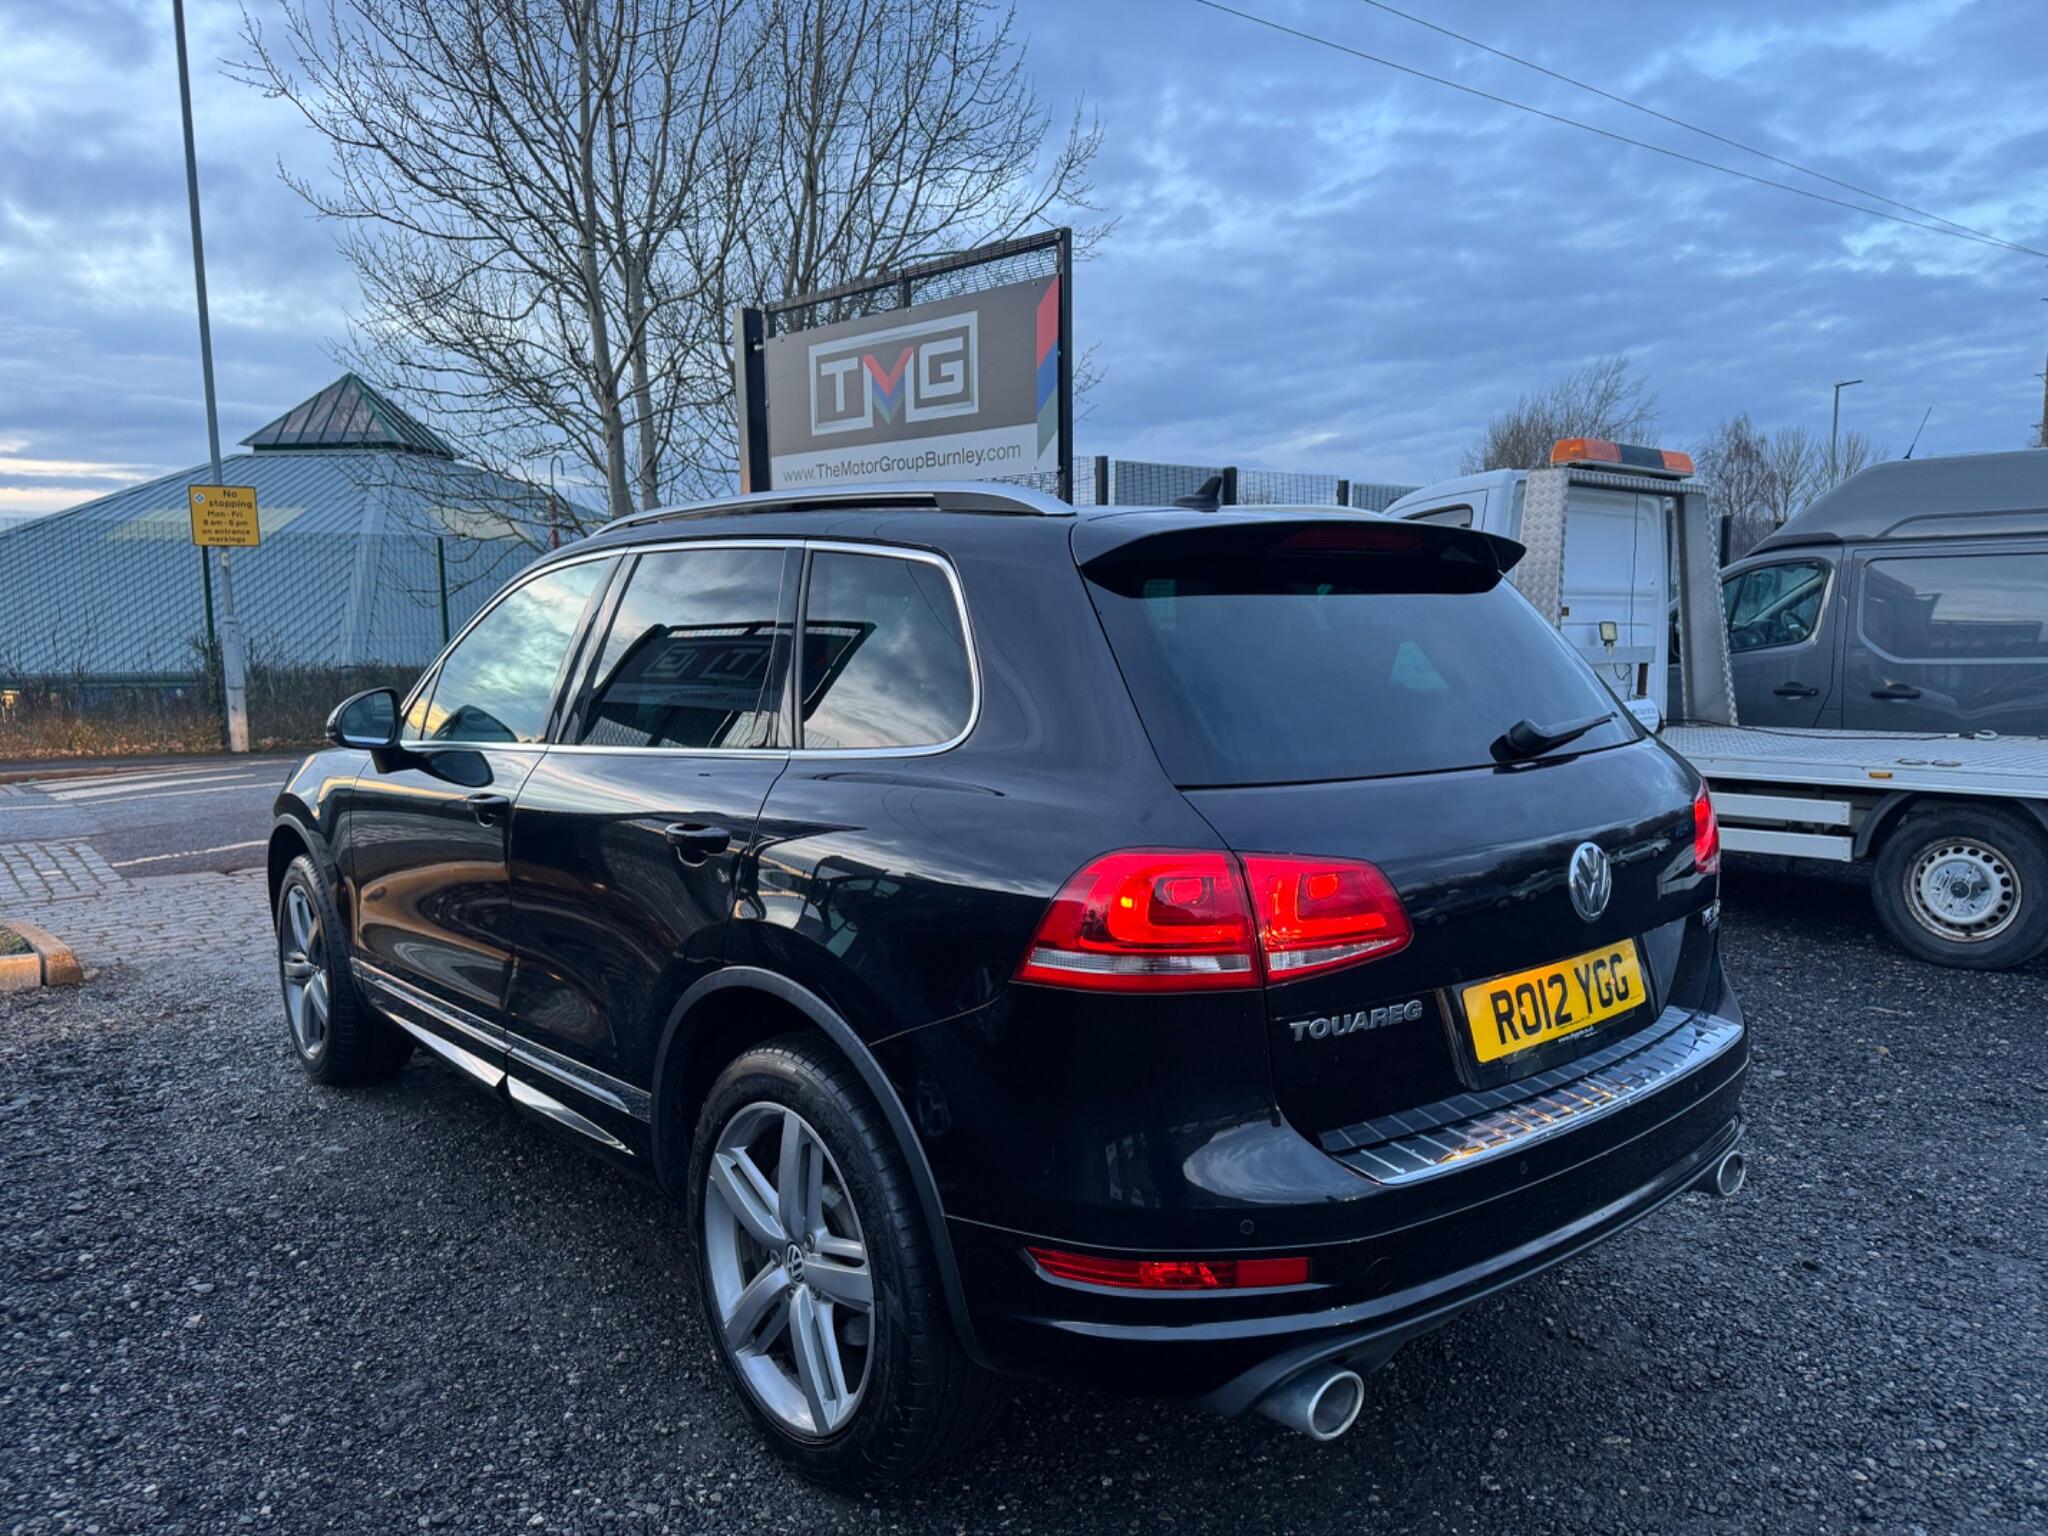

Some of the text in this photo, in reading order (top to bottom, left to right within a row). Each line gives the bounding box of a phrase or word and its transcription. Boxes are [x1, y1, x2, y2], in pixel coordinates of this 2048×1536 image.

[819, 333, 967, 427] TMG
[783, 443, 1021, 483] www.TheMotorGroupBurnley.com
[208, 499, 253, 509] stopping
[223, 489, 237, 498] No
[1489, 952, 1630, 1045] RO12 YGG
[1289, 999, 1423, 1042] TOUAREG
